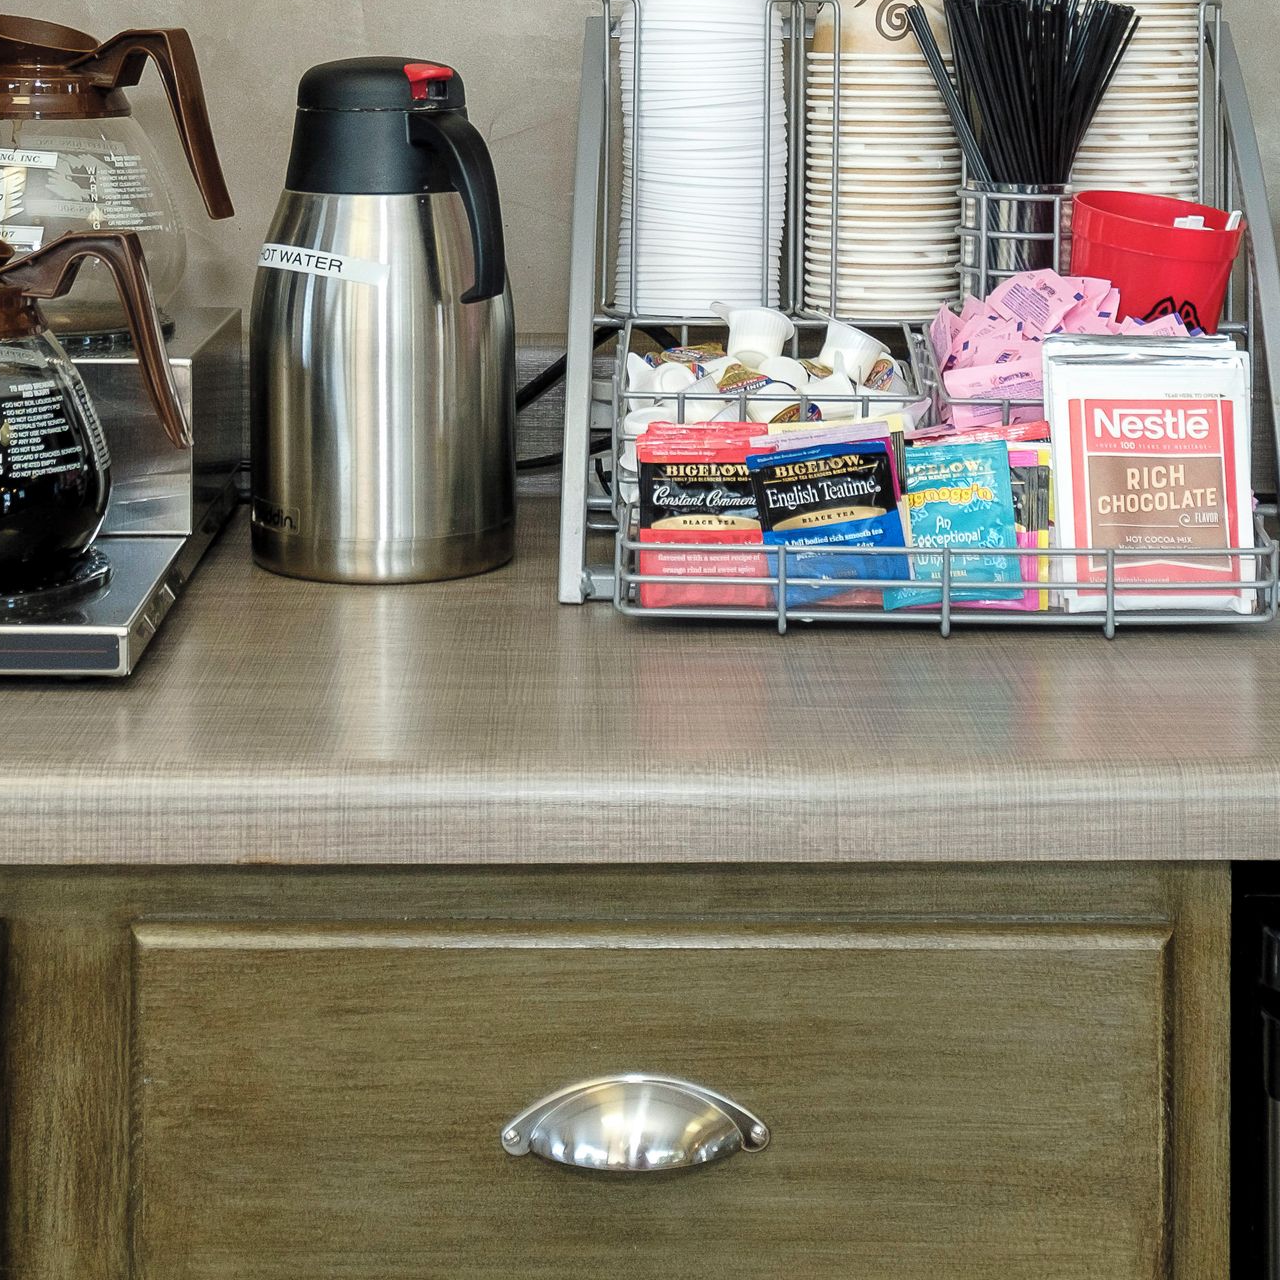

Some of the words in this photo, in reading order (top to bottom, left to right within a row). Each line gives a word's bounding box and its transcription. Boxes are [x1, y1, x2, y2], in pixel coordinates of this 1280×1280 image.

[20, 153, 42, 164] INC.
[280, 250, 343, 273] WATER
[1126, 464, 1185, 490] RICH
[766, 483, 819, 510] English
[819, 479, 875, 501] Teatime
[1098, 488, 1217, 515] CHOCOLATE
[802, 514, 832, 523] BLACK
[936, 515, 951, 534] An
[1195, 512, 1219, 523] FLAVOR
[806, 535, 829, 544] bodied
[829, 533, 844, 541] rich
[845, 530, 871, 540] smooth
[1144, 536, 1174, 544] COCOA
[1176, 536, 1192, 544] MIX
